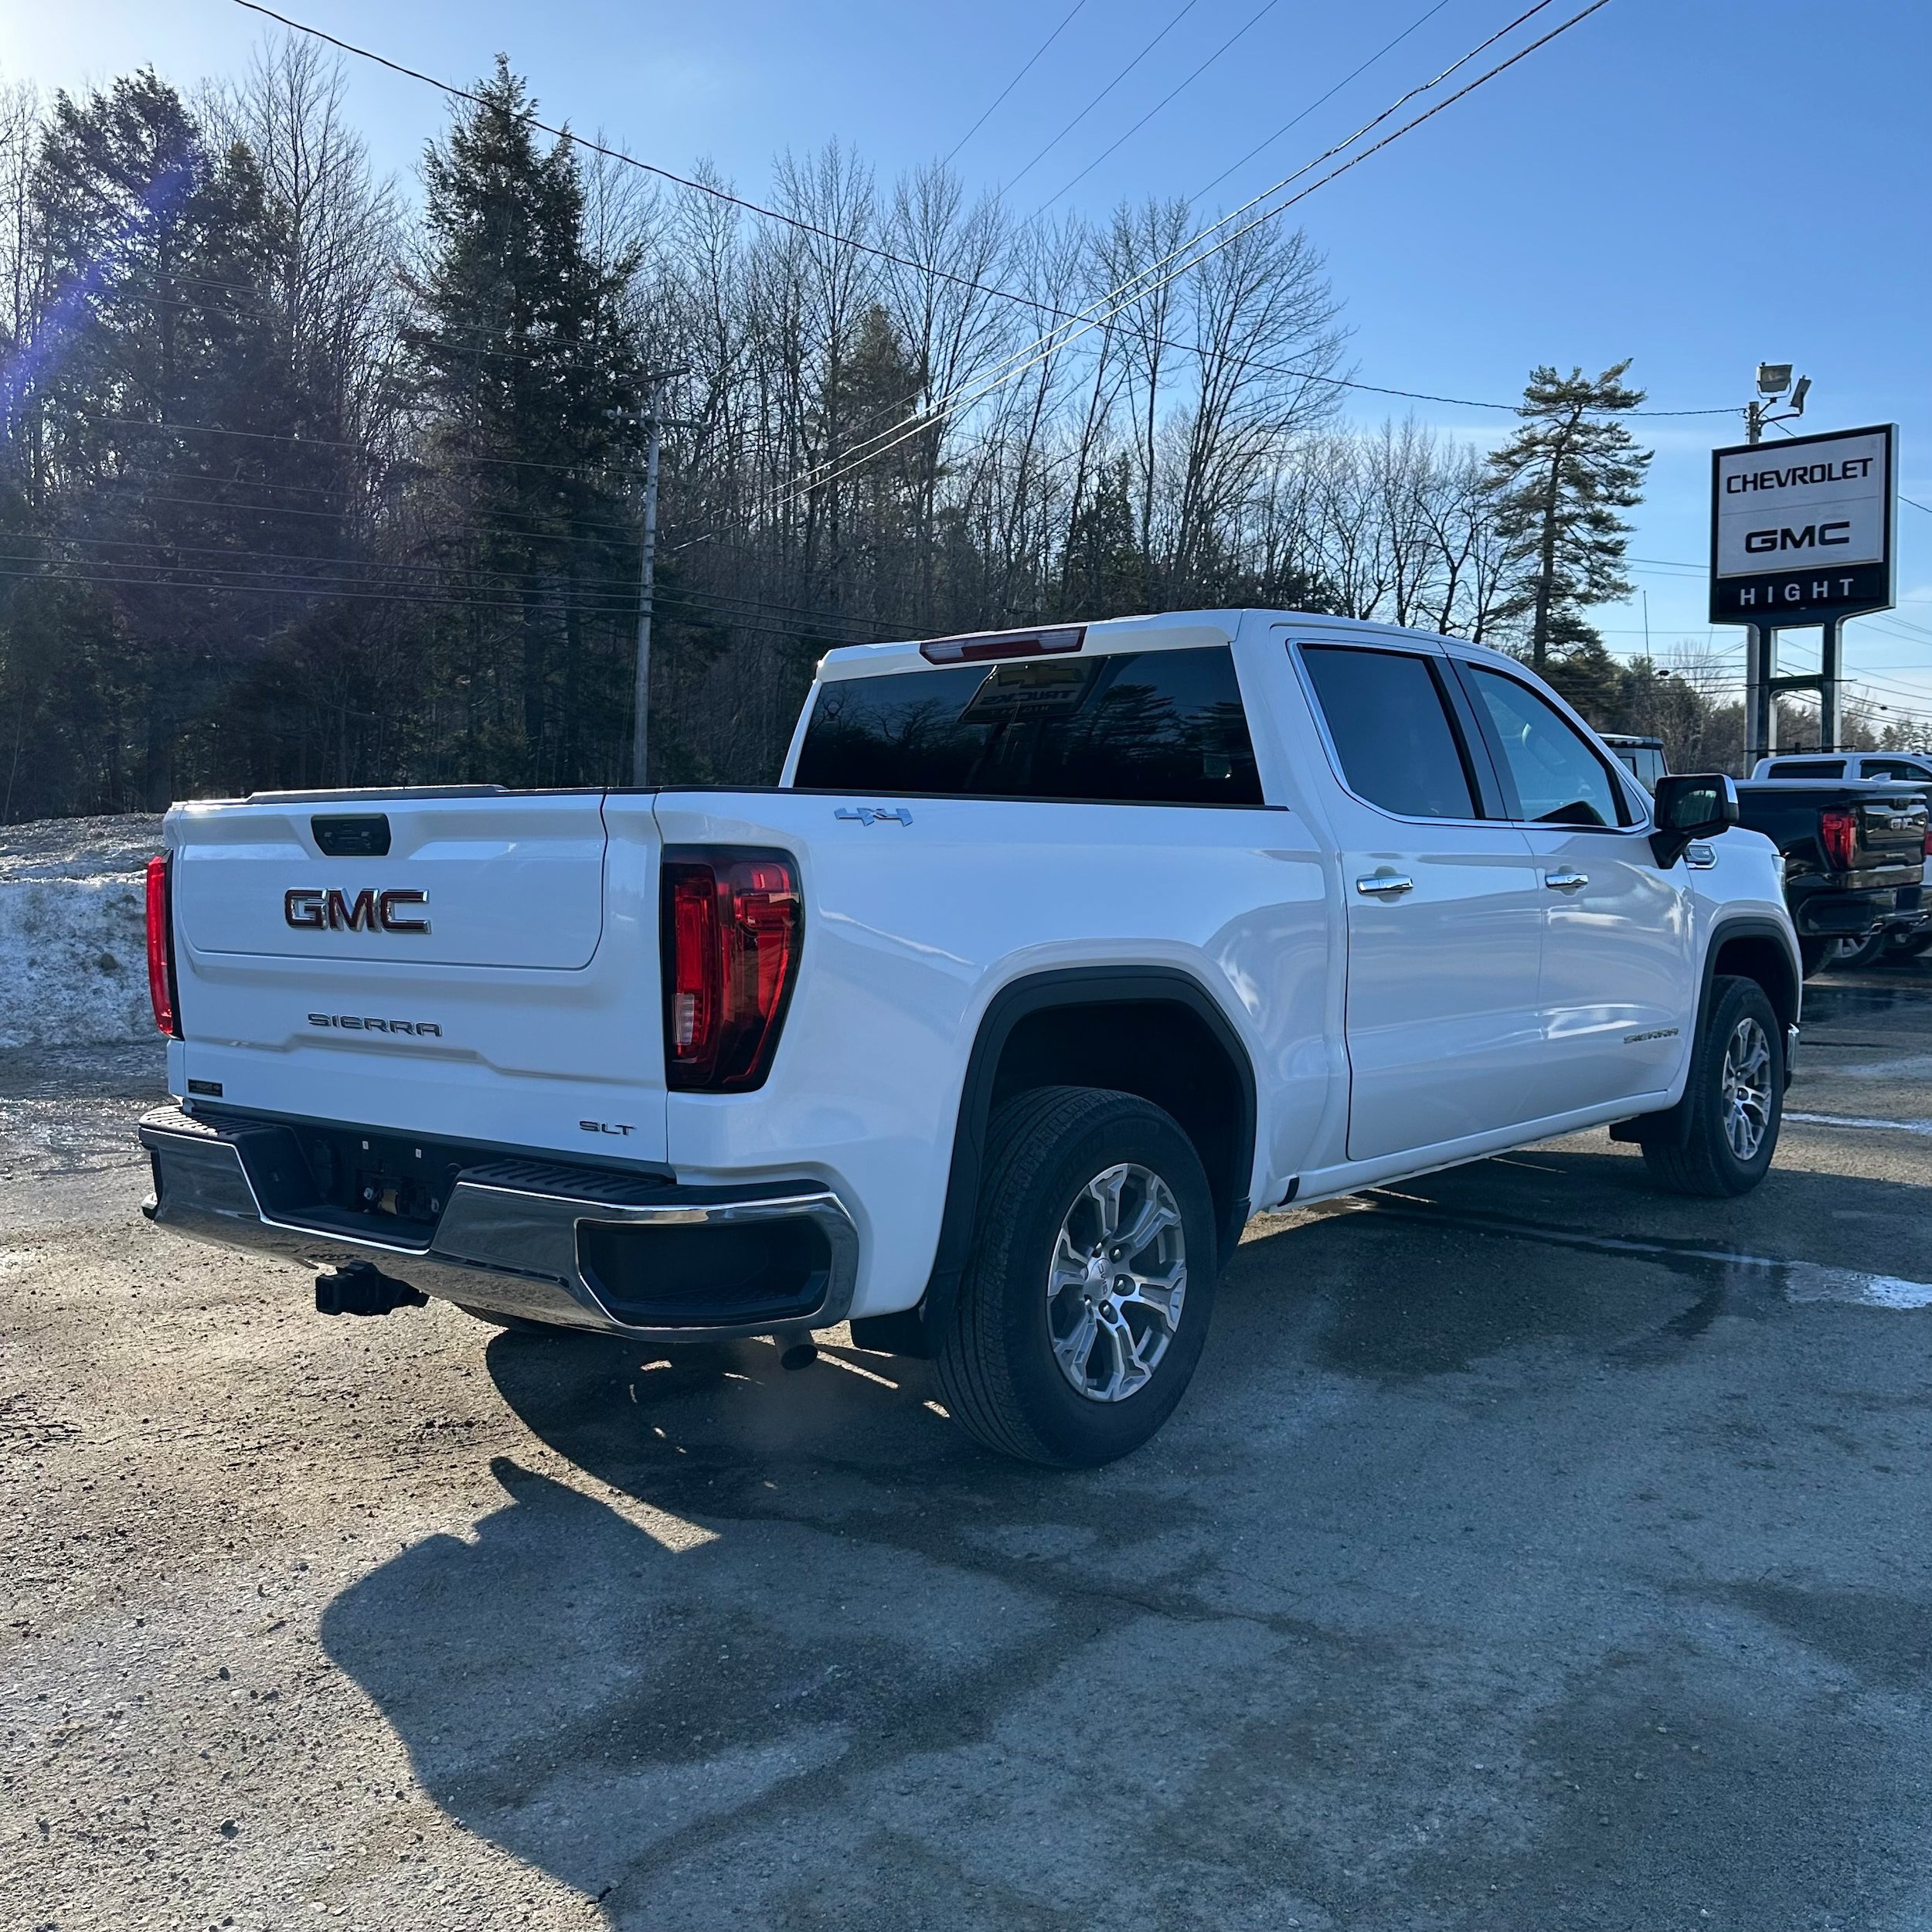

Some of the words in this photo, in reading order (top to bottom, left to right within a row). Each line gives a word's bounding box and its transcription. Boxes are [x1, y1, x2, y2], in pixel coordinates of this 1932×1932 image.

[1726, 457, 1873, 494] CHEVROLET
[1745, 521, 1850, 553] GMC
[1740, 578, 1854, 606] HIGHT
[284, 887, 431, 934] GMC
[308, 1012, 443, 1037] SIERRA
[580, 1121, 637, 1137] SLT
